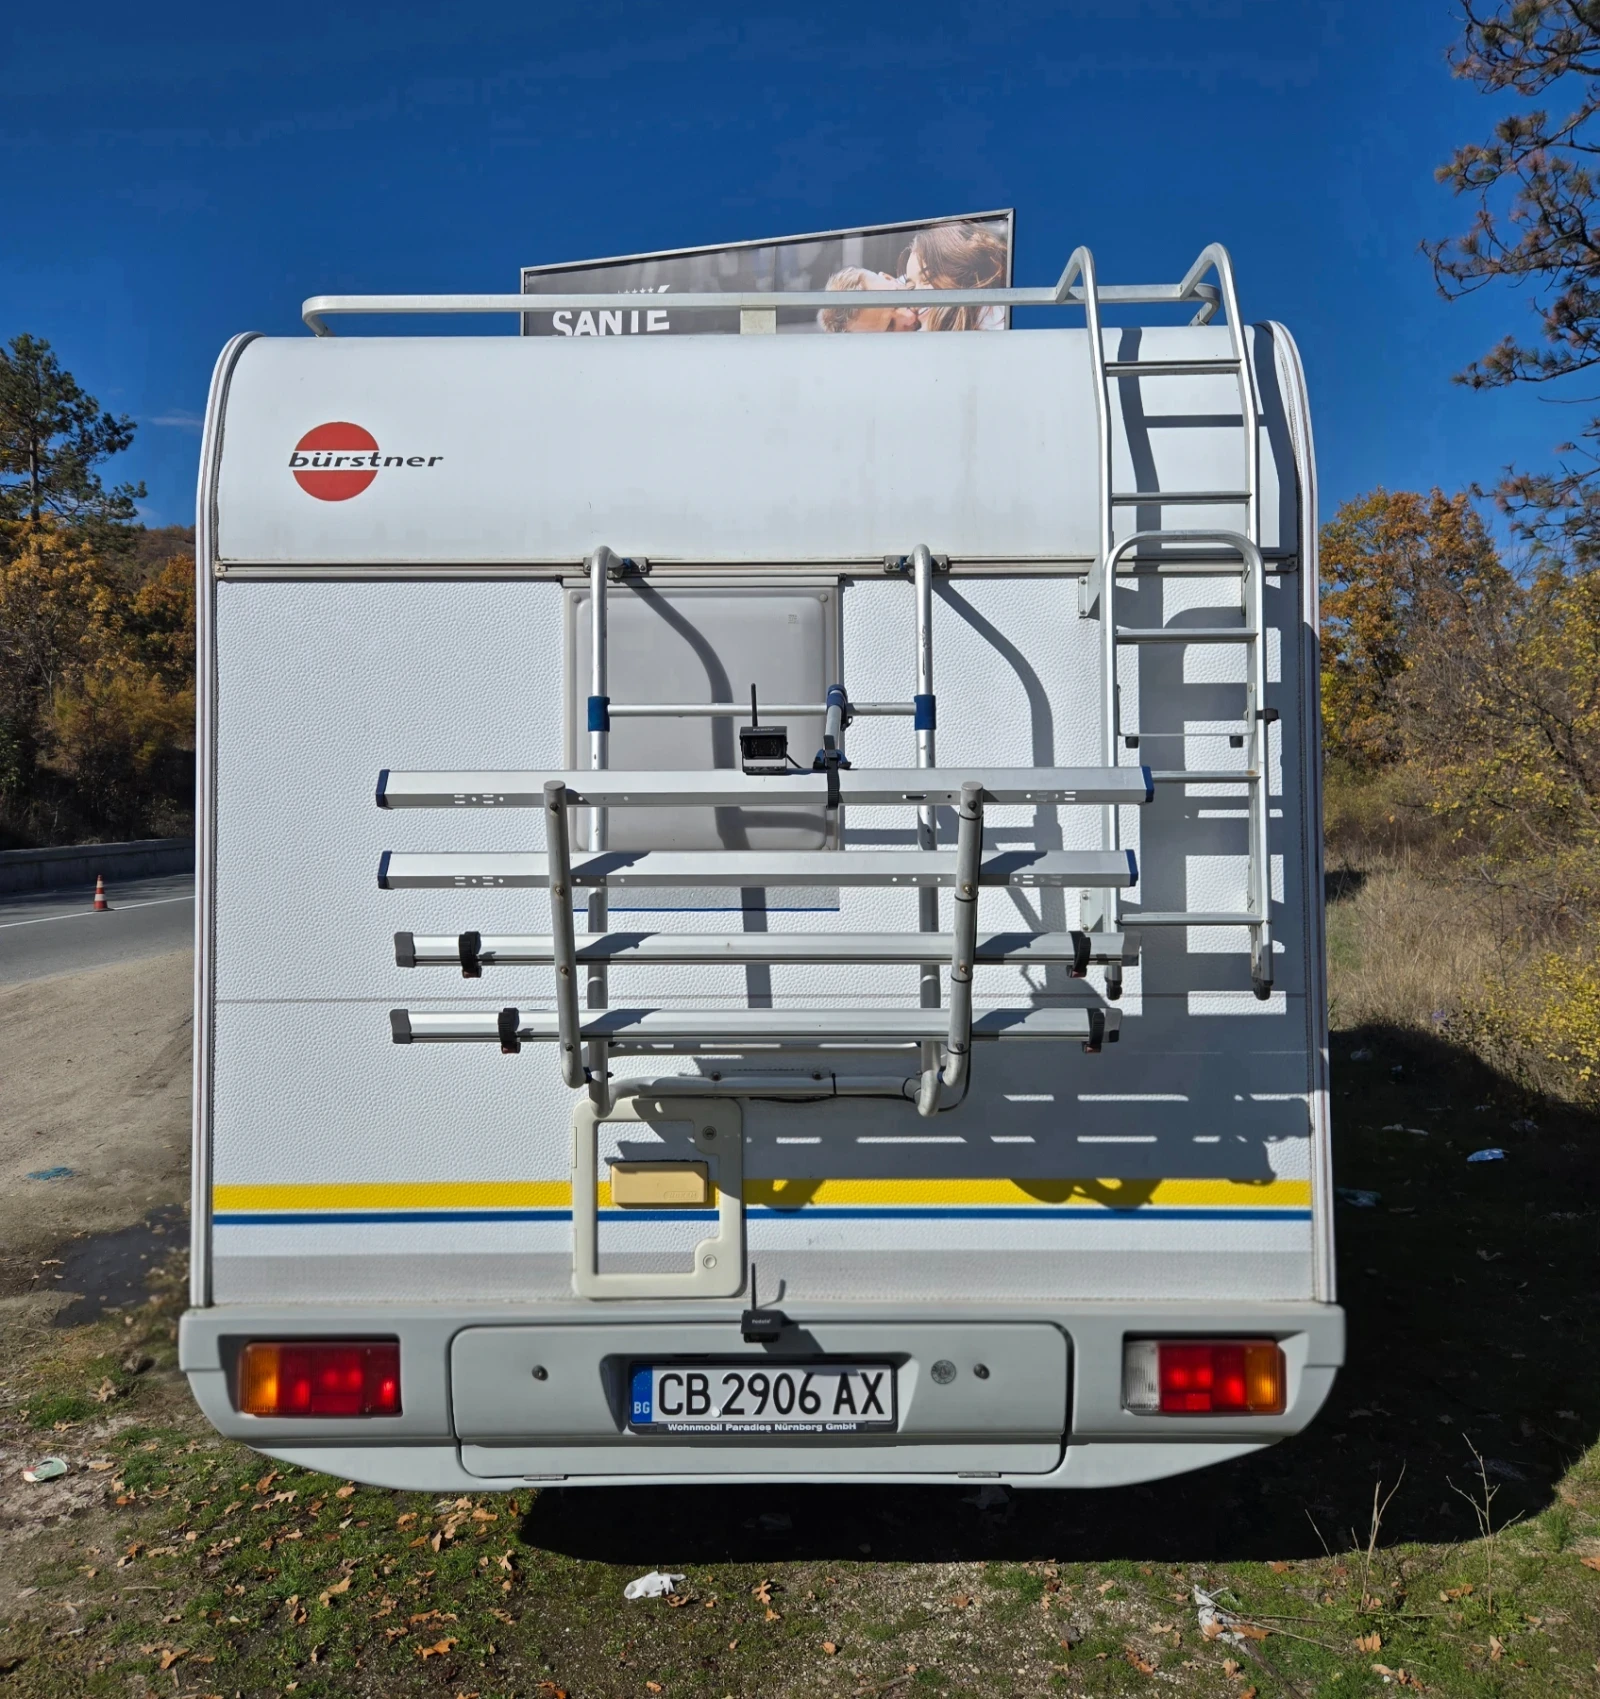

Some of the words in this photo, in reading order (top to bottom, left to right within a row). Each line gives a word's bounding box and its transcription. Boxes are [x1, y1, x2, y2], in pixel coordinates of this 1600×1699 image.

[288, 452, 444, 468] bürstner
[658, 1372, 711, 1416] CB
[721, 1372, 821, 1416] 2906
[833, 1372, 885, 1415] AX
[633, 1401, 651, 1415] BG
[668, 1422, 723, 1432] Wohnmobil
[725, 1422, 771, 1432] Paradies
[774, 1422, 823, 1432] Nürnberg
[826, 1422, 857, 1431] GmbH
